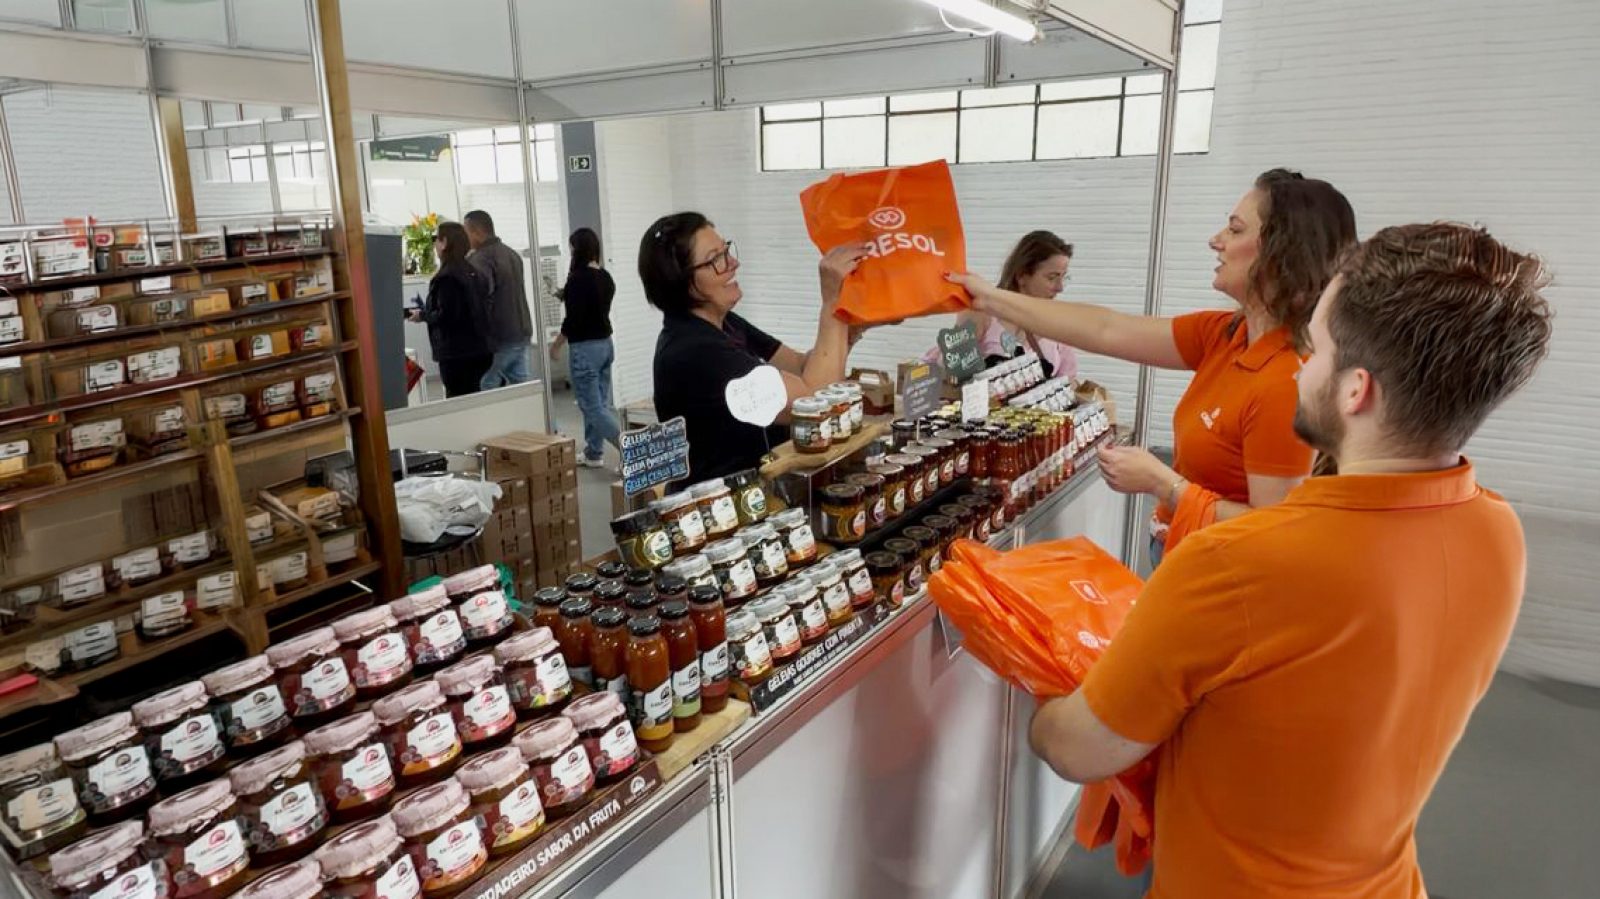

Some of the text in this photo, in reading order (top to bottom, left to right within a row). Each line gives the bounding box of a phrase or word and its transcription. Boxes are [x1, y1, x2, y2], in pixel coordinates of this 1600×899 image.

[862, 232, 945, 259] RESOL
[768, 664, 796, 692] GELEIAS
[536, 832, 573, 866] SABOR
[572, 821, 590, 841] DA
[589, 799, 621, 829] FRUTA
